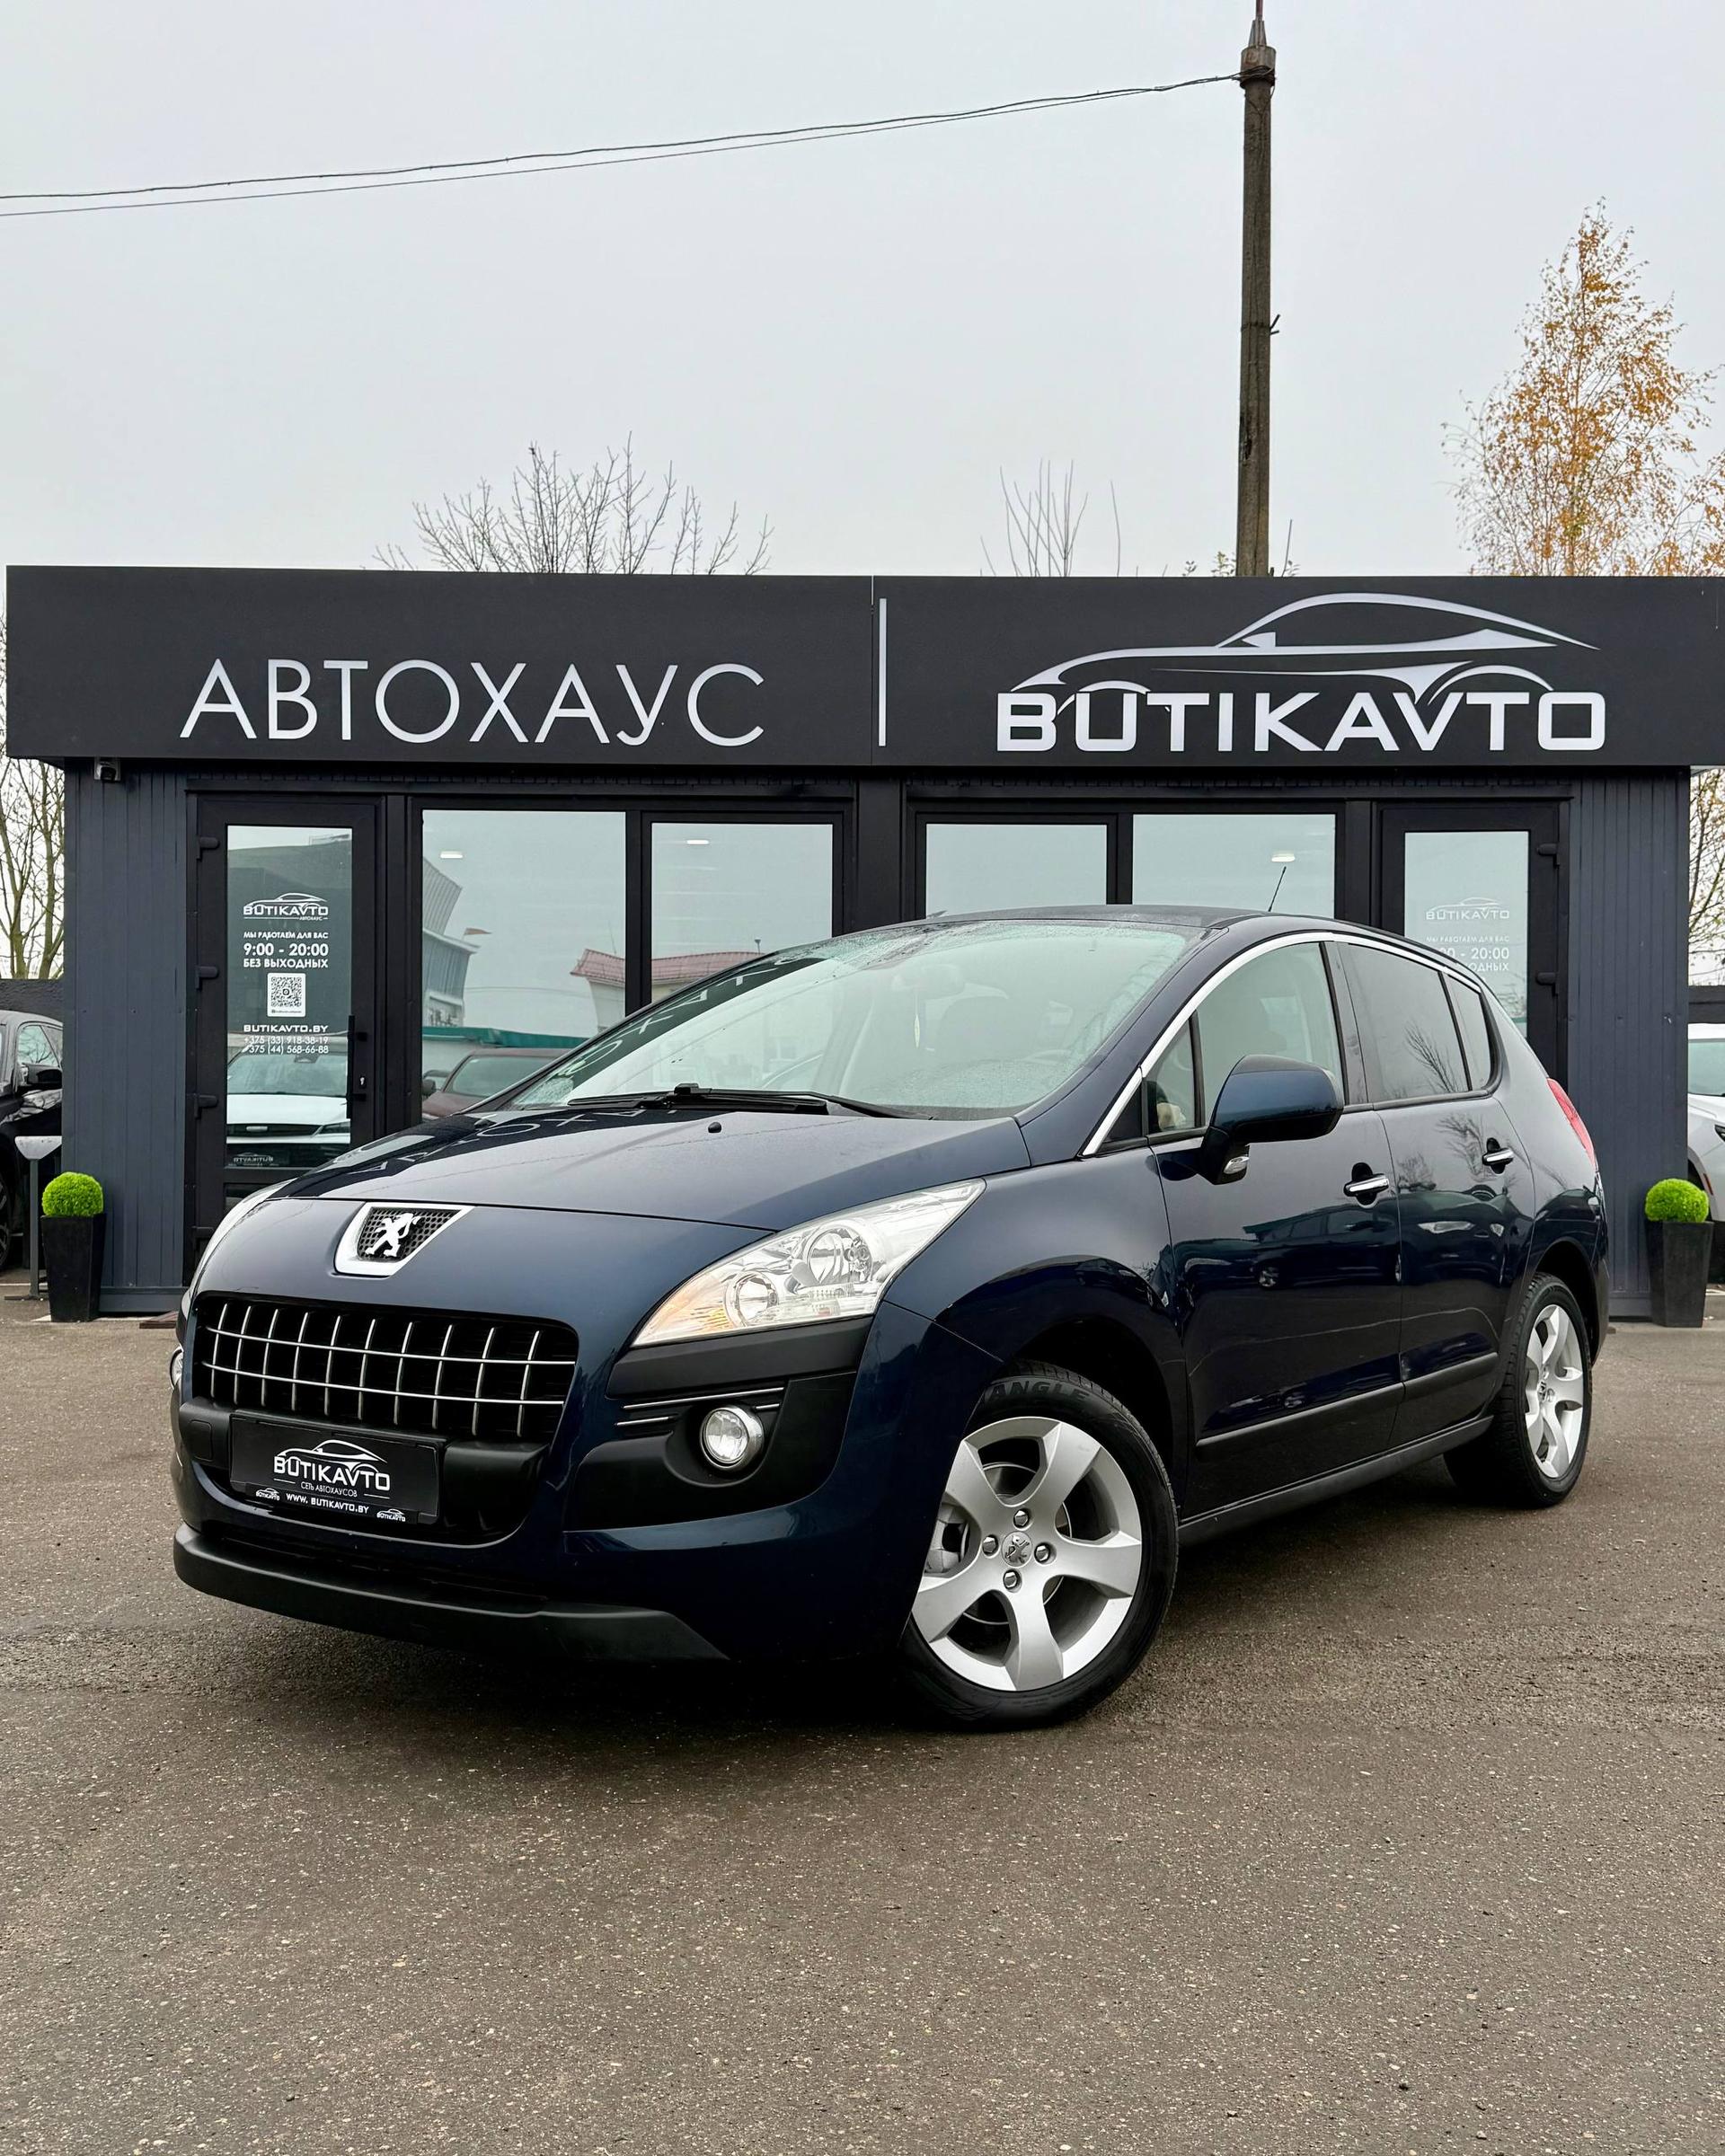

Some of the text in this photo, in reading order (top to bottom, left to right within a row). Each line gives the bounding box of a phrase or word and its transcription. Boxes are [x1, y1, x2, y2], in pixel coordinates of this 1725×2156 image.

[179, 658, 765, 747] АВТОХАУС
[996, 691, 1606, 753] BUTIKAVTO
[243, 906, 328, 915] BUTIKAVTO
[1426, 909, 1509, 920] BUTIKAVTO
[258, 932, 296, 940] РАБОТАЕМ
[243, 942, 274, 956] 9:00
[288, 942, 329, 956] 20:00
[1471, 947, 1509, 959] 20:00
[243, 958, 329, 968] БЕЗ ВЫХОДНЫХ
[1466, 962, 1509, 972] ОДНЫХ
[243, 1024, 329, 1032] BUTIKAVTO.BY
[244, 1036, 265, 1044] +375
[268, 1036, 284, 1046] (33)
[268, 1045, 284, 1056] (44)
[287, 1045, 329, 1054] 568-66-88
[273, 1456, 390, 1491] BUTIKAVTO
[301, 1481, 358, 1498] СЕТЬ АВТОХАУСОВ
[311, 1497, 369, 1515] BUTIKAVTO.BY
